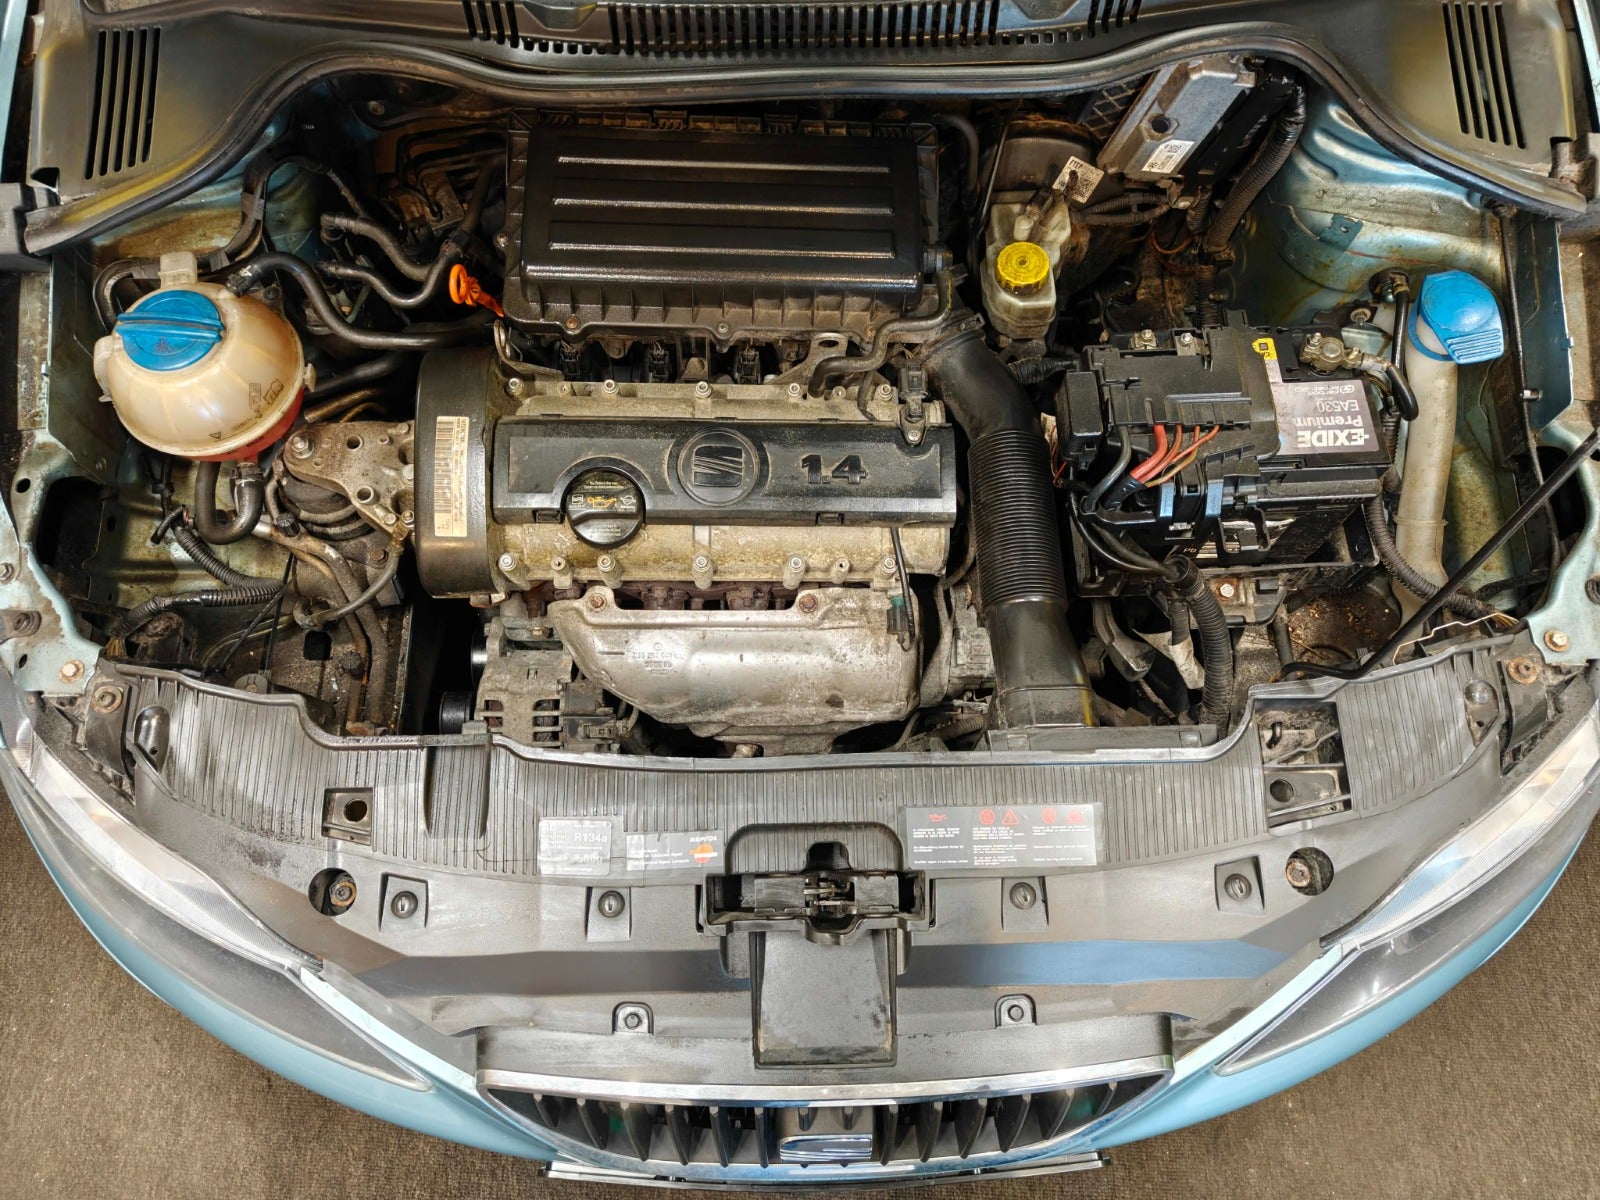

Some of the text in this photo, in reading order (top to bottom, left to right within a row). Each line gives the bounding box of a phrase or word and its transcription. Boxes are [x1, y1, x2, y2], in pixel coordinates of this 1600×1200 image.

[1316, 399, 1359, 412] EA530
[1293, 415, 1364, 429] Premium
[1297, 428, 1369, 448] EXIDE
[801, 454, 867, 484] 1.4
[574, 832, 607, 843] R134a
[689, 835, 718, 843] REPSOL
